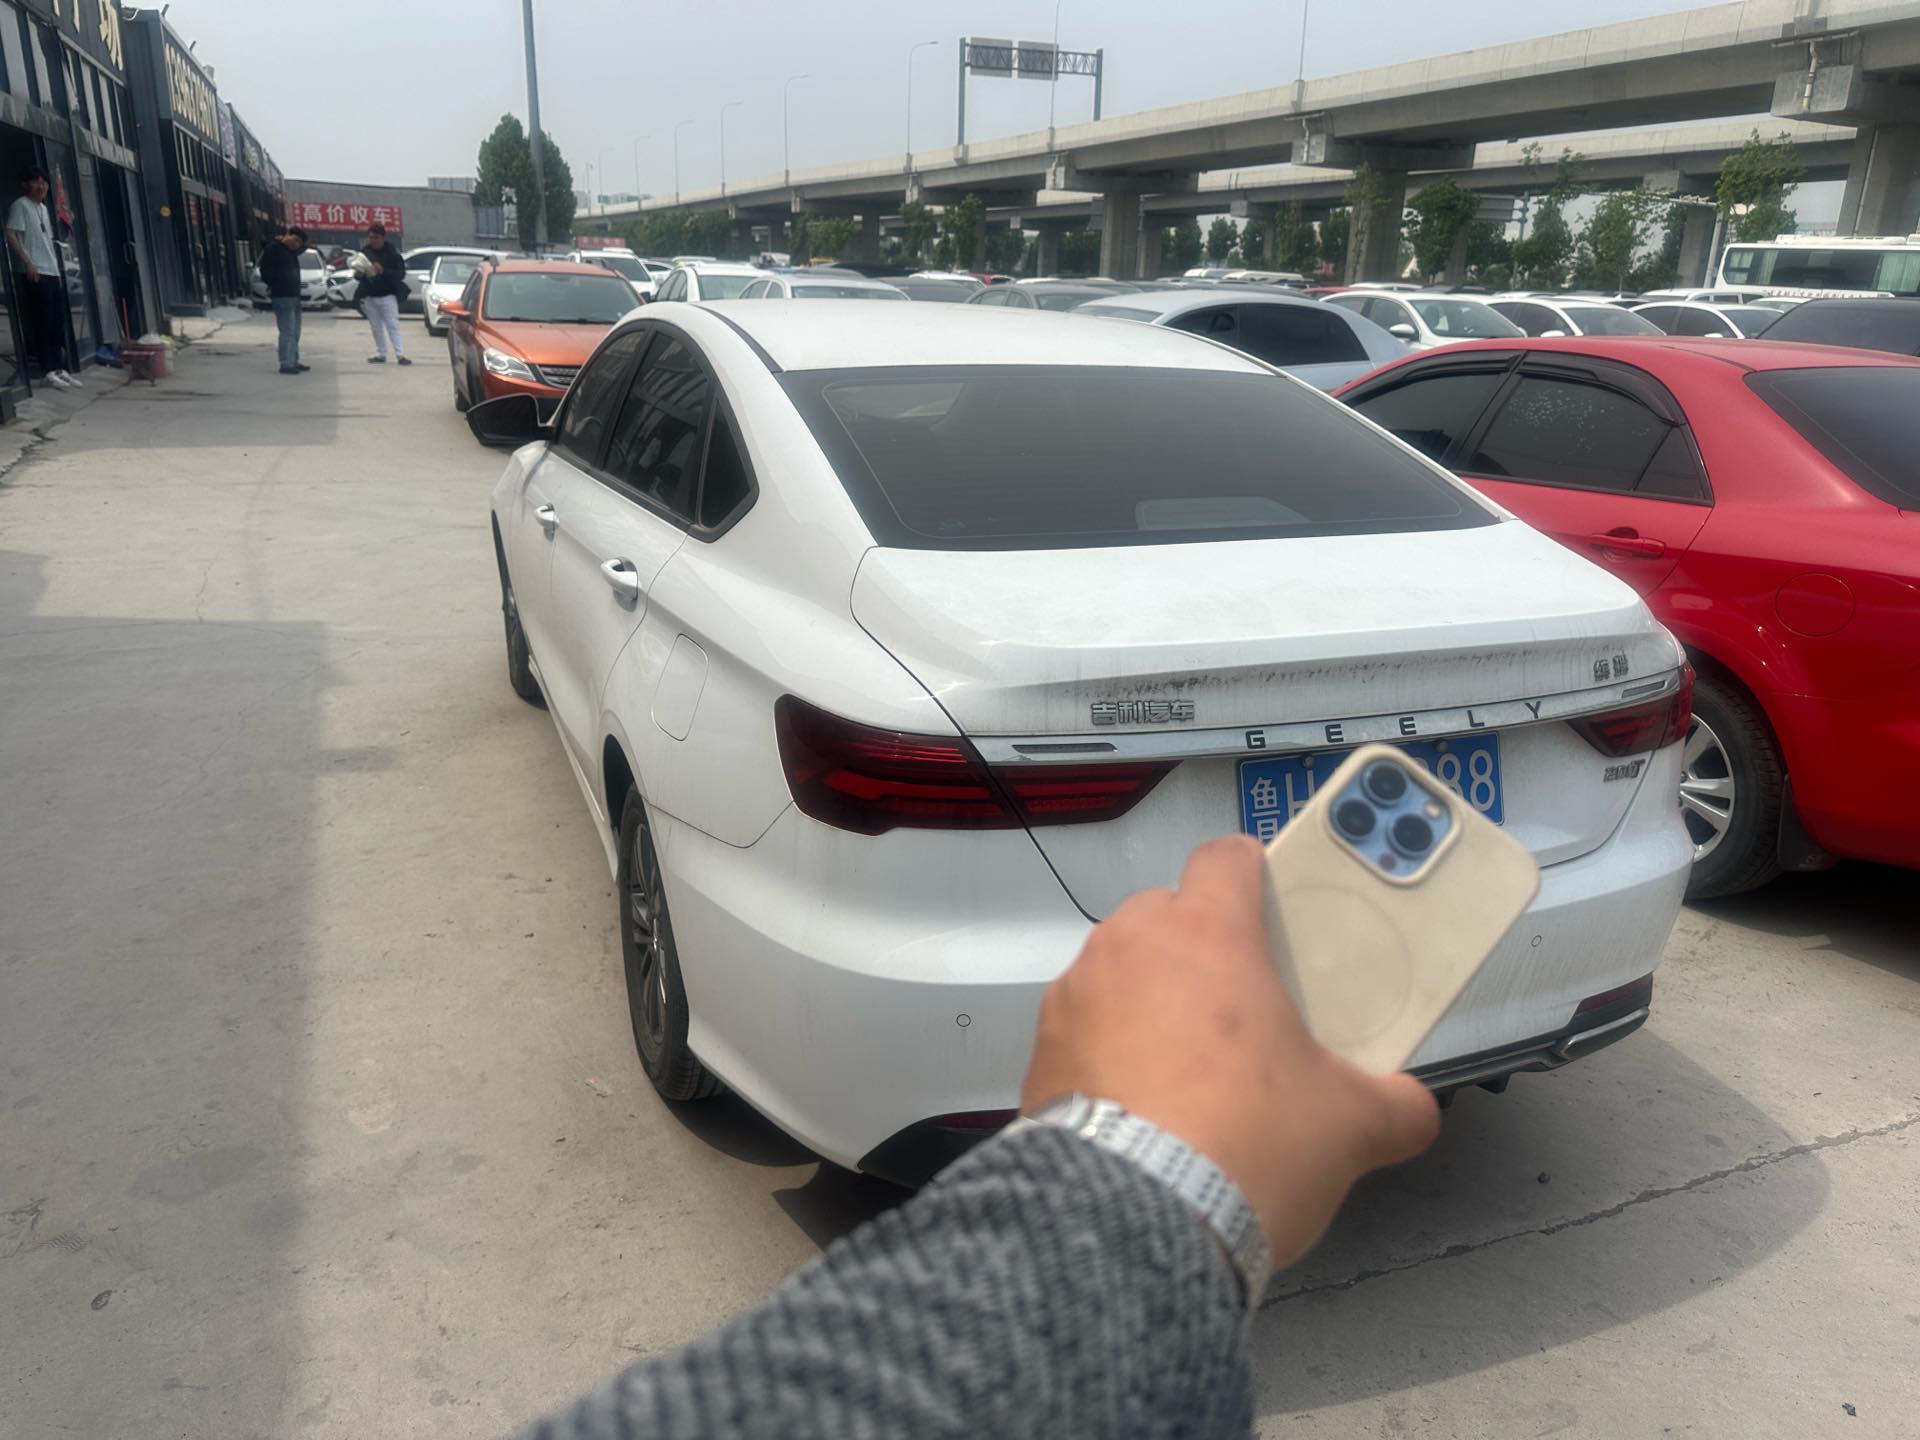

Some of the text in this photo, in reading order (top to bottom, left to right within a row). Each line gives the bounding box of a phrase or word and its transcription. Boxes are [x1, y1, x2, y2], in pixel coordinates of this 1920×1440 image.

[302, 204, 393, 225] 高价收车
[1091, 700, 1195, 726] 吉利汽车
[1245, 700, 1542, 750] GEELY
